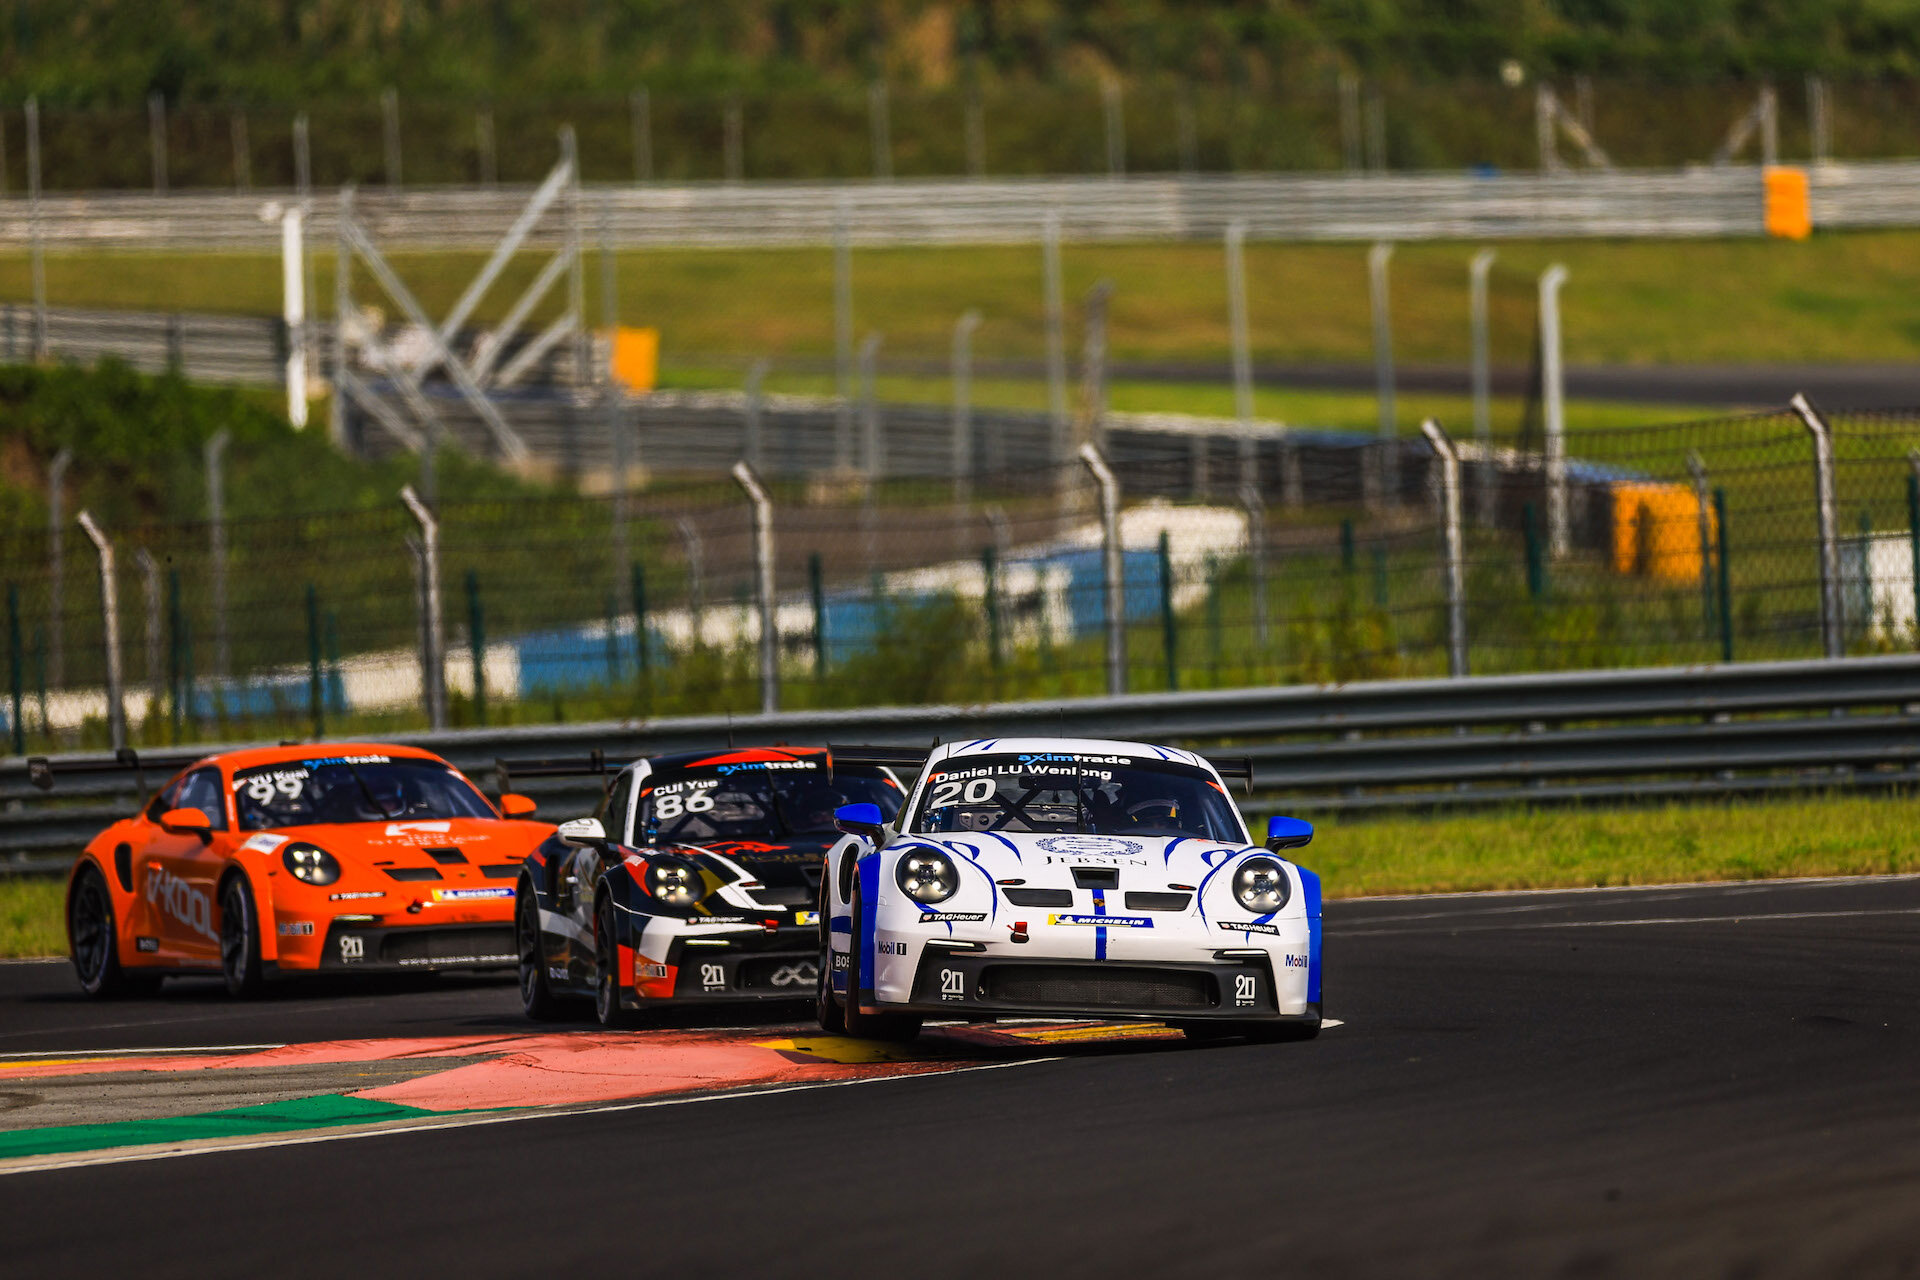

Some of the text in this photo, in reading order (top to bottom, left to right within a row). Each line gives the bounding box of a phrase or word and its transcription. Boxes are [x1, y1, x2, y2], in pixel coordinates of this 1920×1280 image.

[1018, 753, 1131, 765] aximtrade
[717, 761, 817, 776] aximtrade
[936, 766, 993, 784] Daniel
[998, 765, 1019, 775] LU
[248, 778, 303, 807] 99
[653, 779, 719, 797] CUI Yue
[931, 778, 996, 809] 20
[656, 790, 715, 820] 86
[1043, 856, 1147, 866] JEBSEN
[1077, 917, 1145, 926] MICHELIN
[878, 941, 895, 955] Mobil
